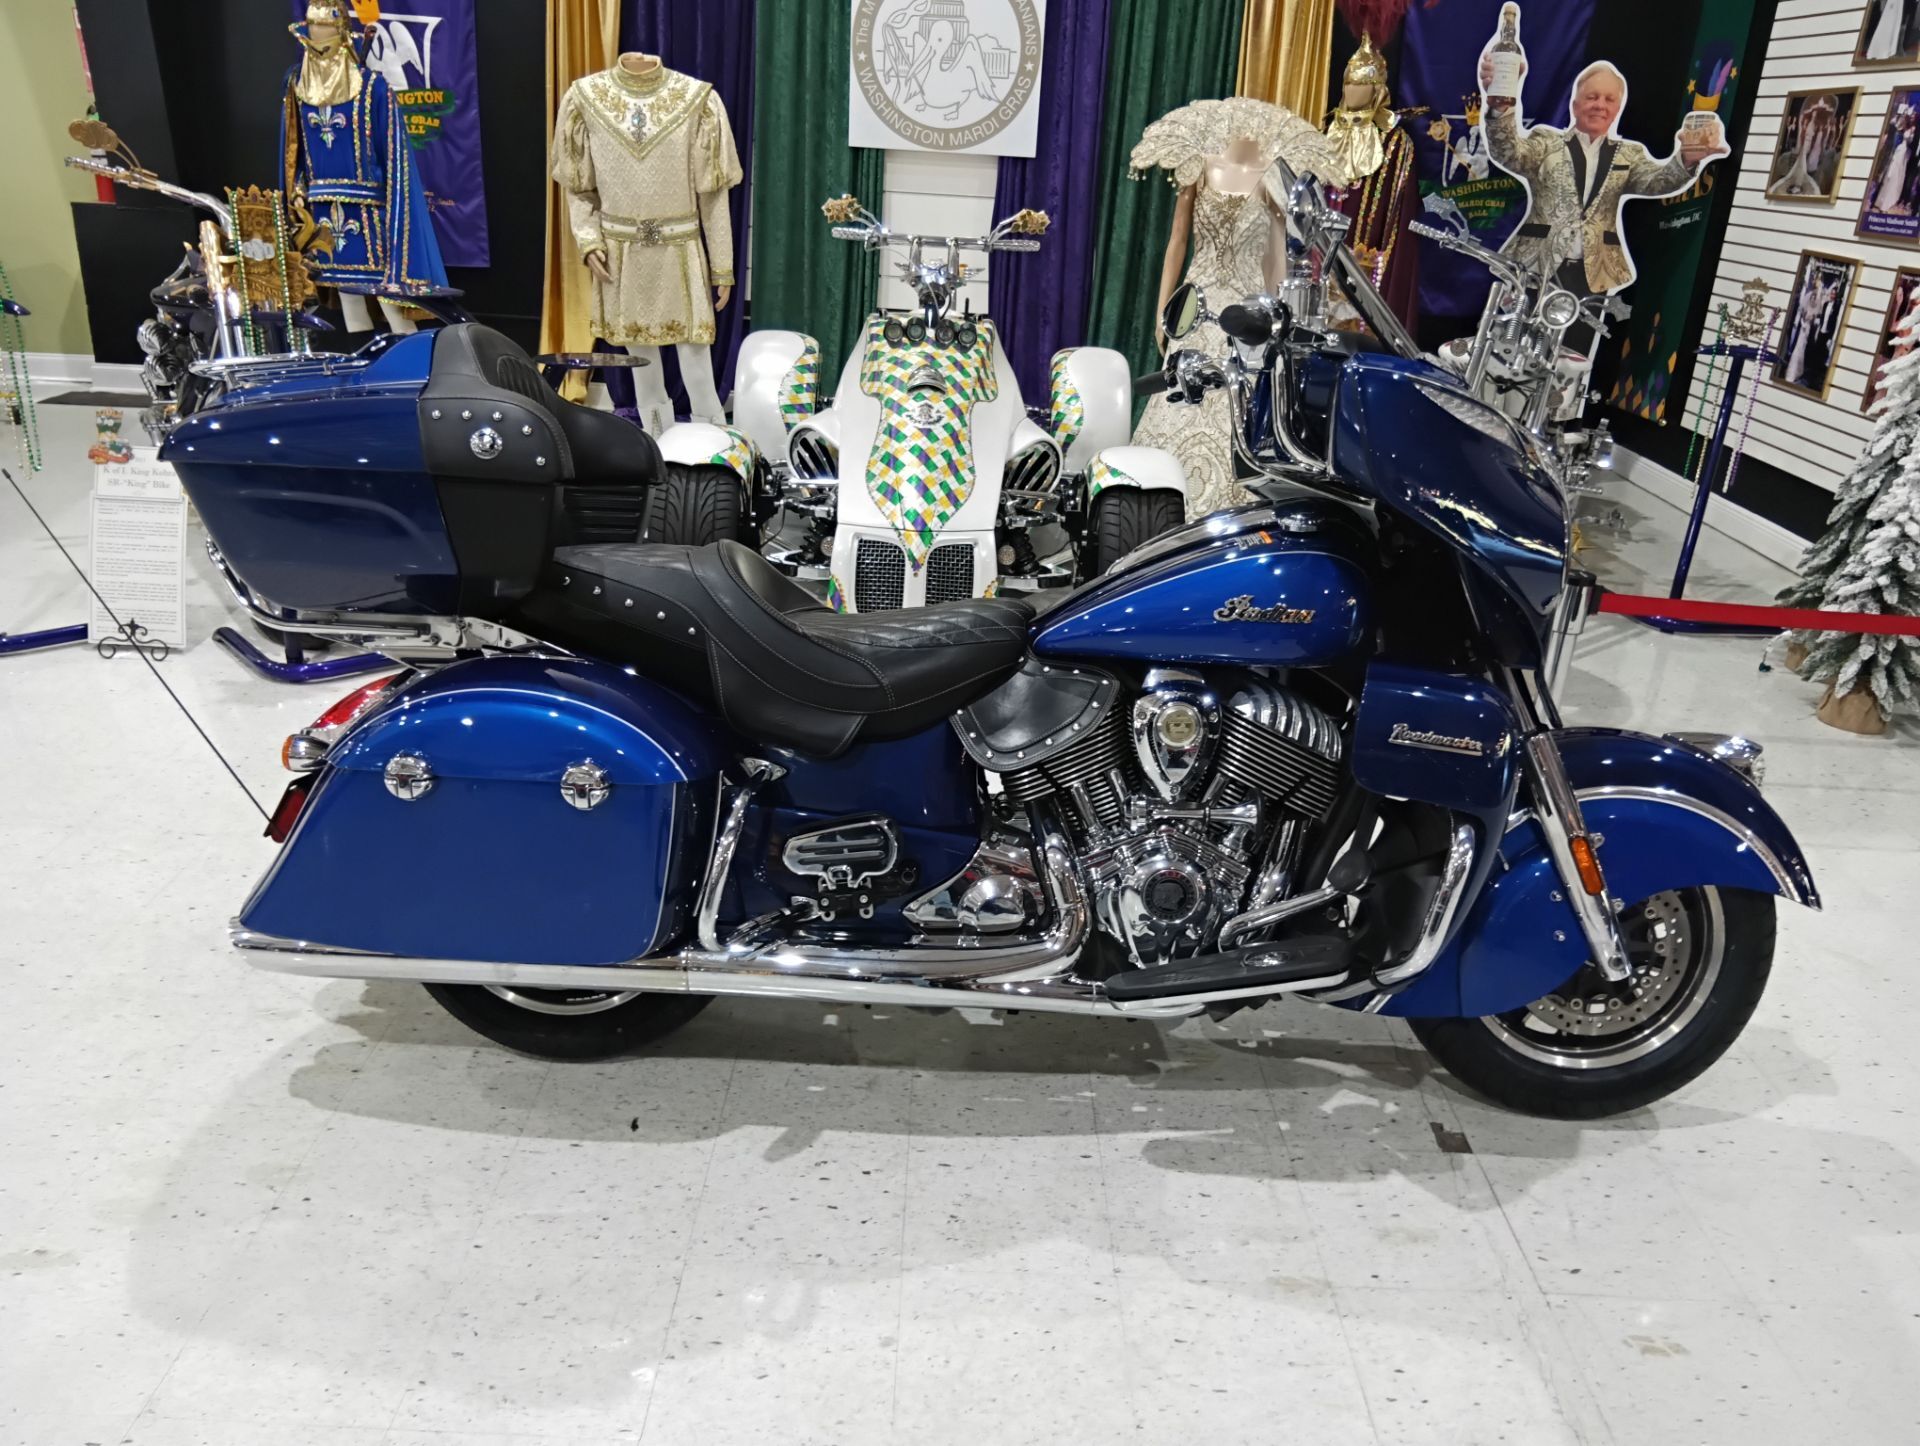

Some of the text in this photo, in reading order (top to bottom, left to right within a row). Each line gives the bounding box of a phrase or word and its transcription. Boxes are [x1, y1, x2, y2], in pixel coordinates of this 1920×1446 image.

[855, 18, 871, 46] The
[858, 66, 1032, 146] WASHINGTON MARDI GRAS
[410, 115, 441, 127] GRAS
[1440, 178, 1516, 198] WASHINGTON
[1458, 199, 1484, 208] MARDI
[1213, 594, 1316, 624] Indian
[1389, 722, 1483, 753] Roadmaster
